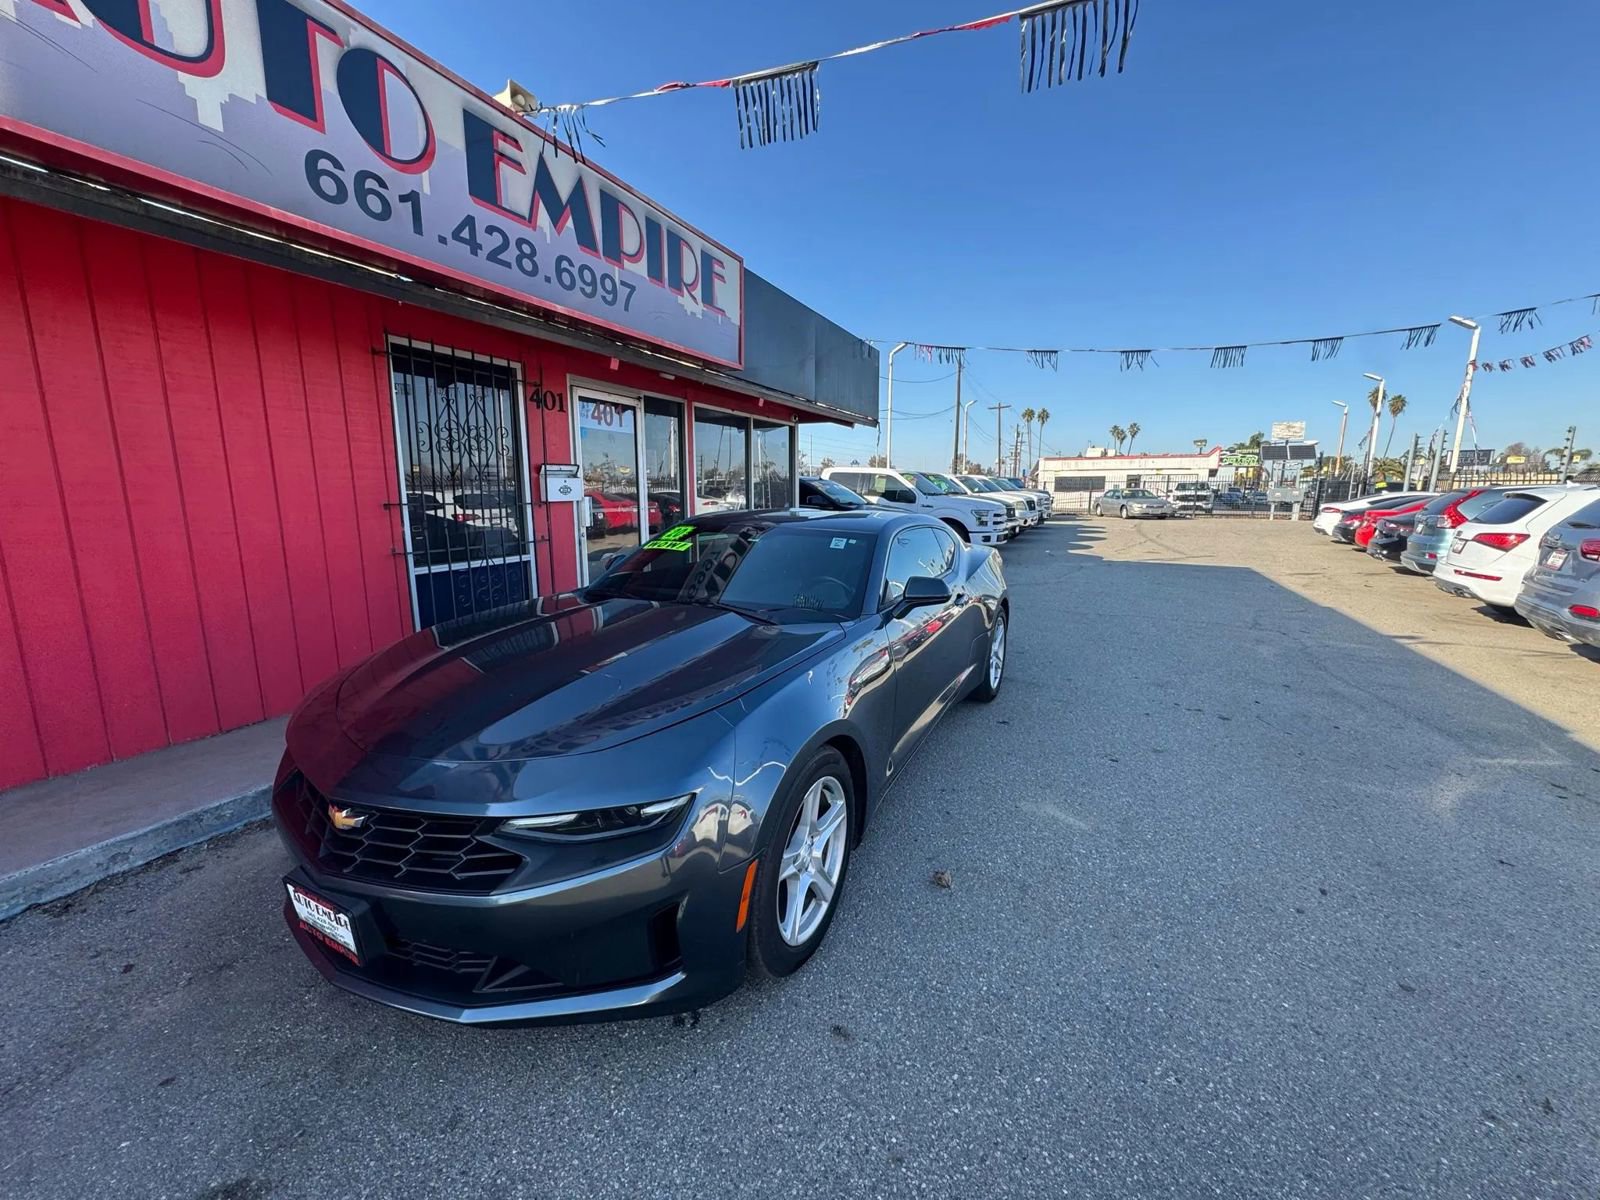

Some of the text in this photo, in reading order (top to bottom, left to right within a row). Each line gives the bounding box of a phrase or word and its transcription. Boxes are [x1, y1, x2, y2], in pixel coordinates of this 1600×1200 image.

[30, 0, 727, 317] TO EMPIRE
[304, 150, 637, 313] 661.428.6997
[529, 387, 567, 413] 401
[590, 401, 624, 428] 401
